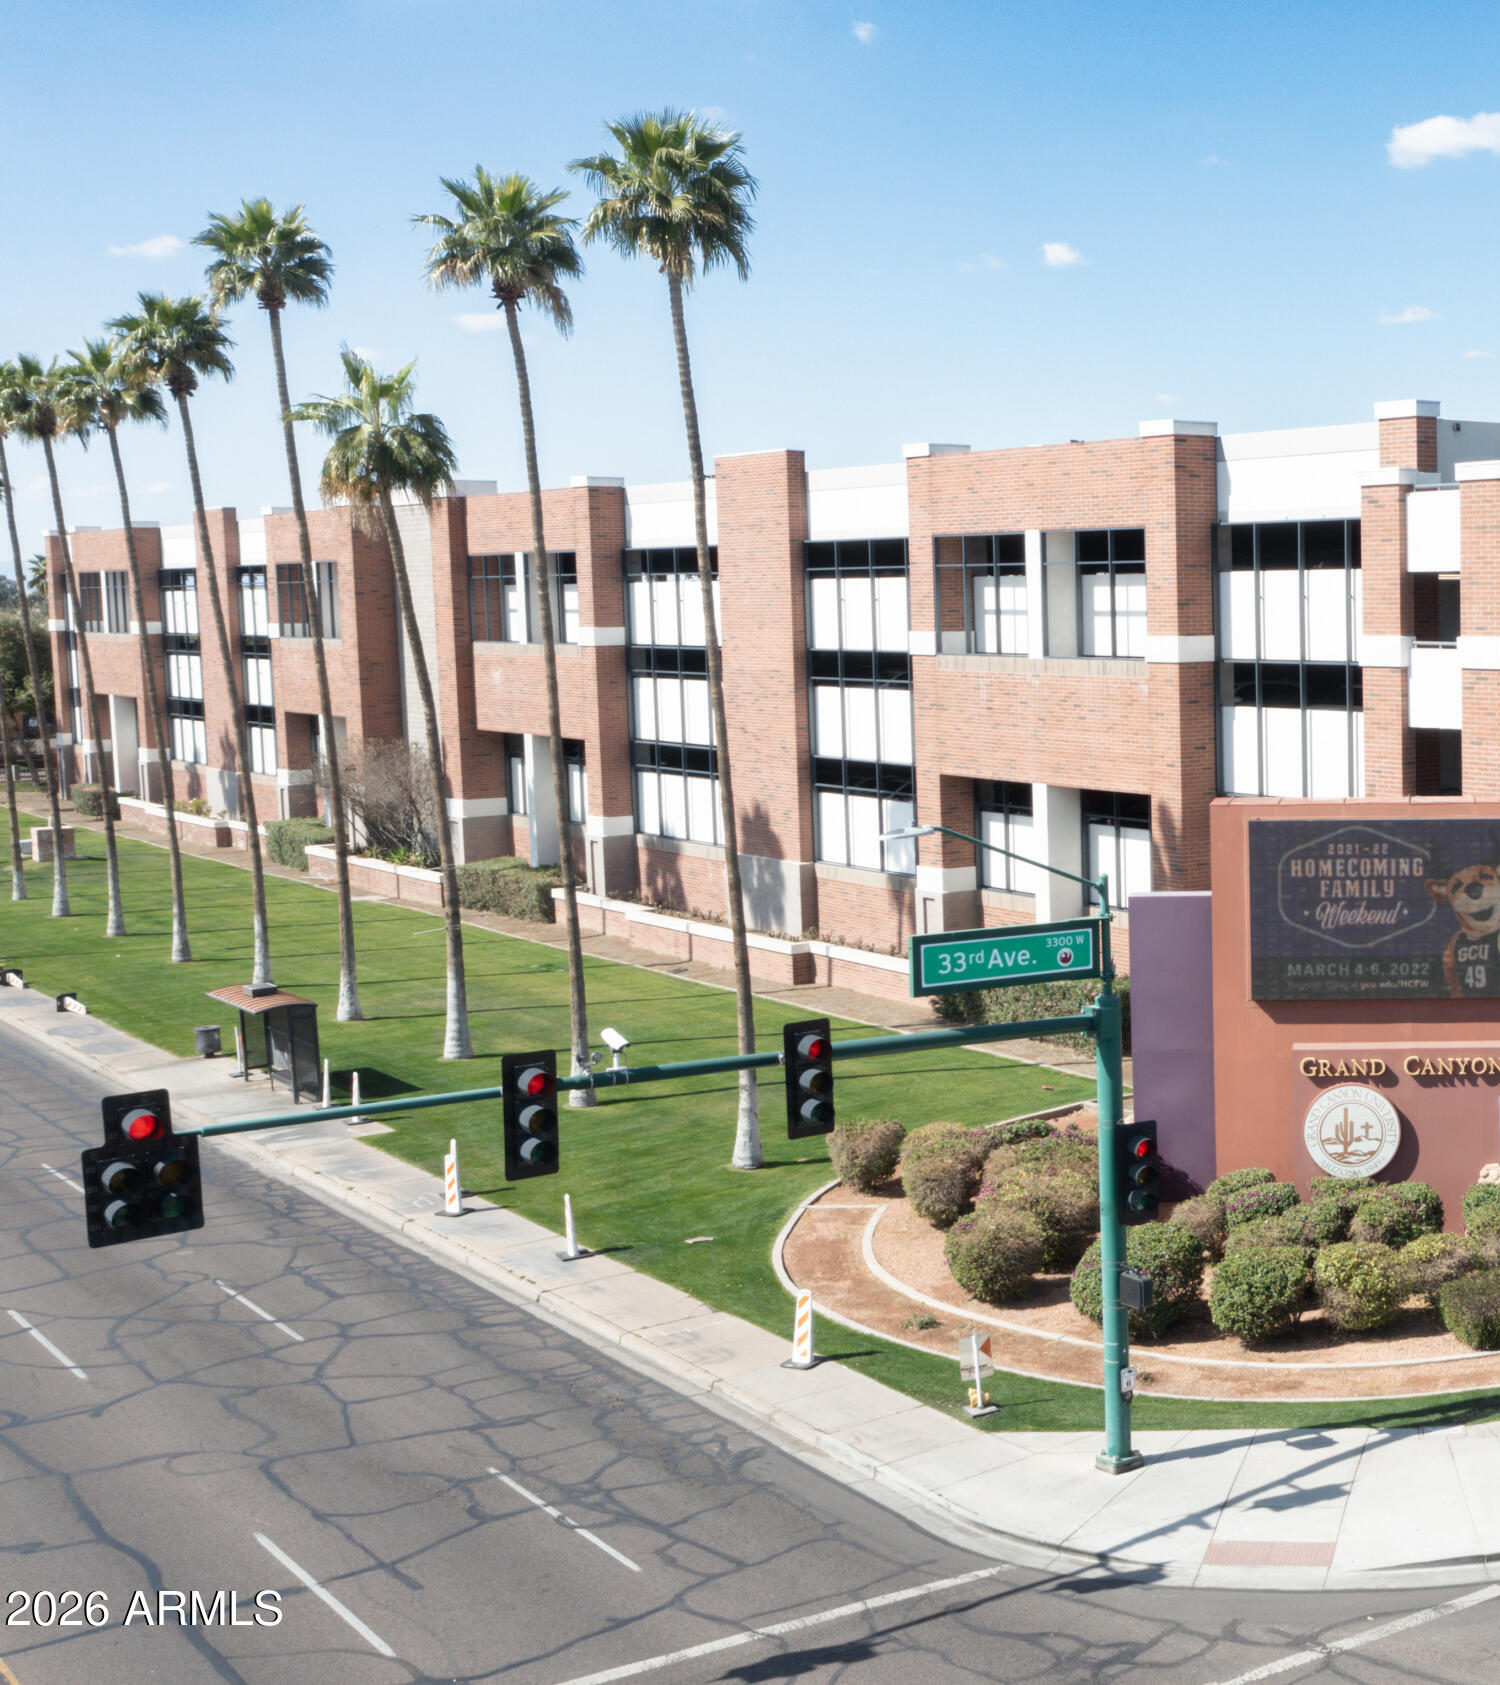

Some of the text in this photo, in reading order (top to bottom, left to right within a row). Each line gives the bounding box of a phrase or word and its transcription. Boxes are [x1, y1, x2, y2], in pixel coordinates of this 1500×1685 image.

[1290, 858, 1424, 878] HOMECOMING
[1320, 880, 1395, 898] FAMILY
[1315, 900, 1402, 929] Weekend
[1045, 935, 1085, 948] 3300 W
[938, 948, 1037, 975] 33rd Ave.
[1458, 944, 1490, 962] GCU
[1287, 962, 1430, 976] MARCH 4-6, 2022
[1465, 965, 1487, 988] 49
[1300, 1057, 1386, 1077] GRAND
